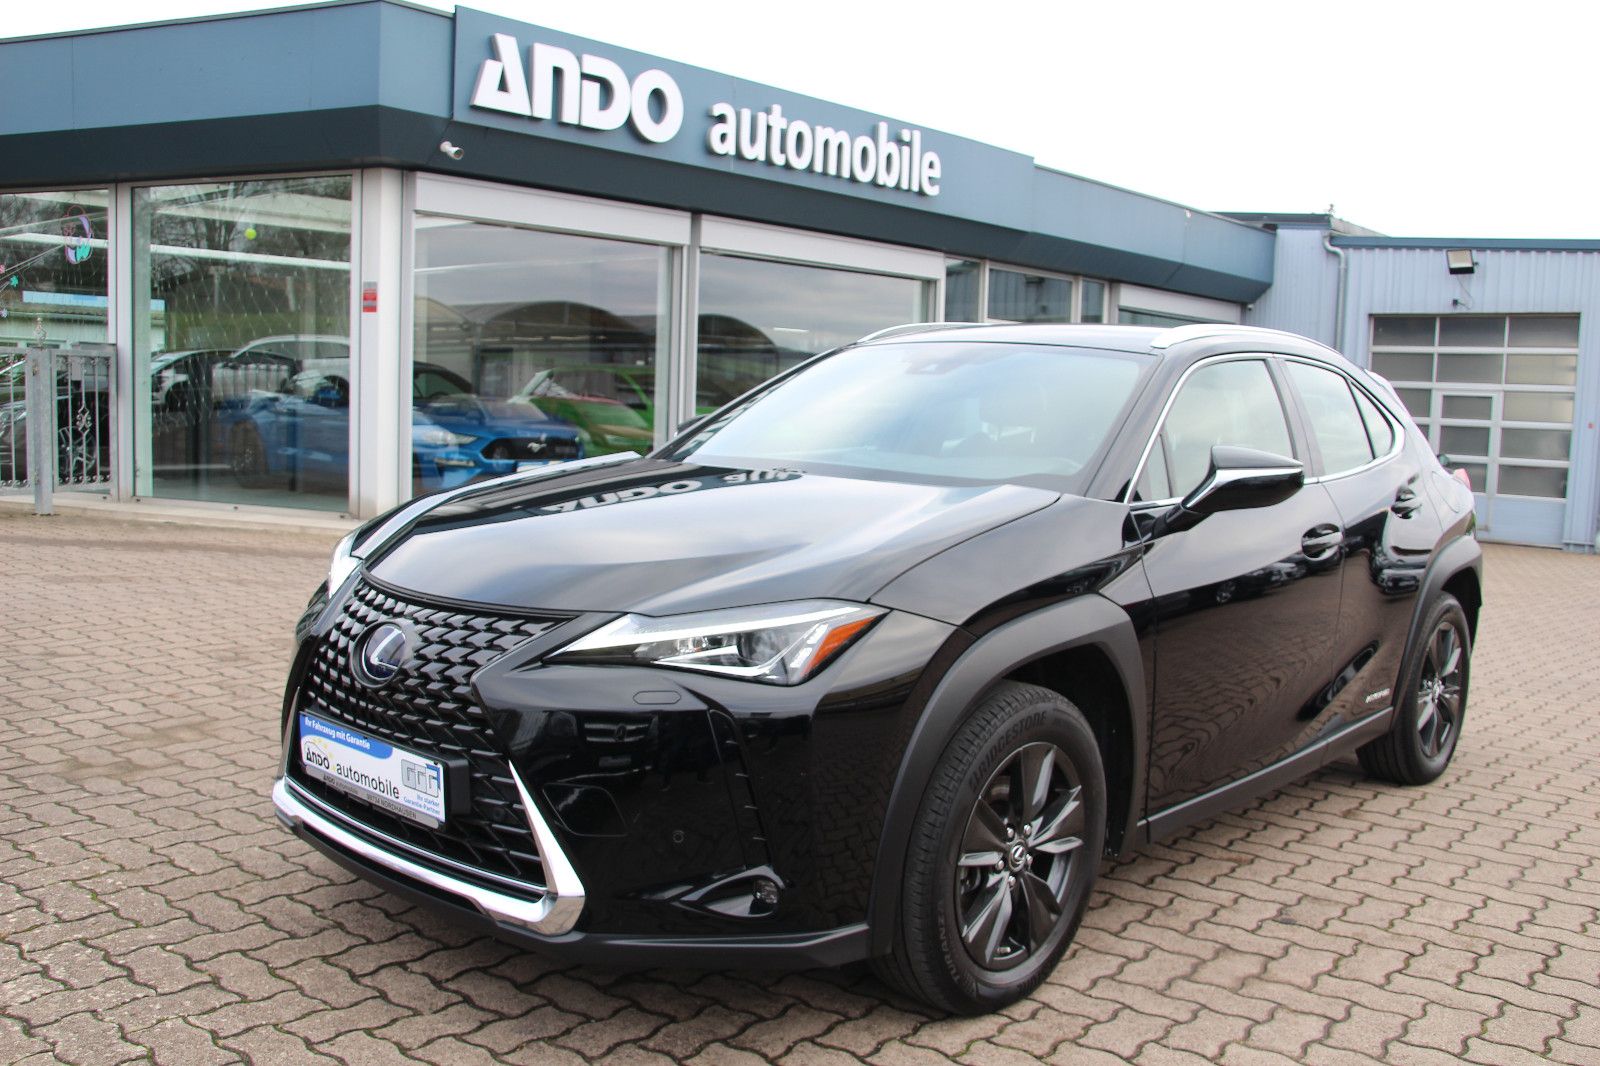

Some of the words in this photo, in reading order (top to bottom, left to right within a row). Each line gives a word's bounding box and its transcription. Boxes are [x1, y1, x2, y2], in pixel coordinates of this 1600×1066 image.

[470, 33, 684, 143] ANDO
[708, 102, 942, 196] automobile
[312, 720, 336, 738] Fahrzeug
[336, 730, 346, 741] mit
[345, 733, 371, 750] Garantie
[306, 747, 330, 770] ANDO
[336, 763, 400, 799] automobile
